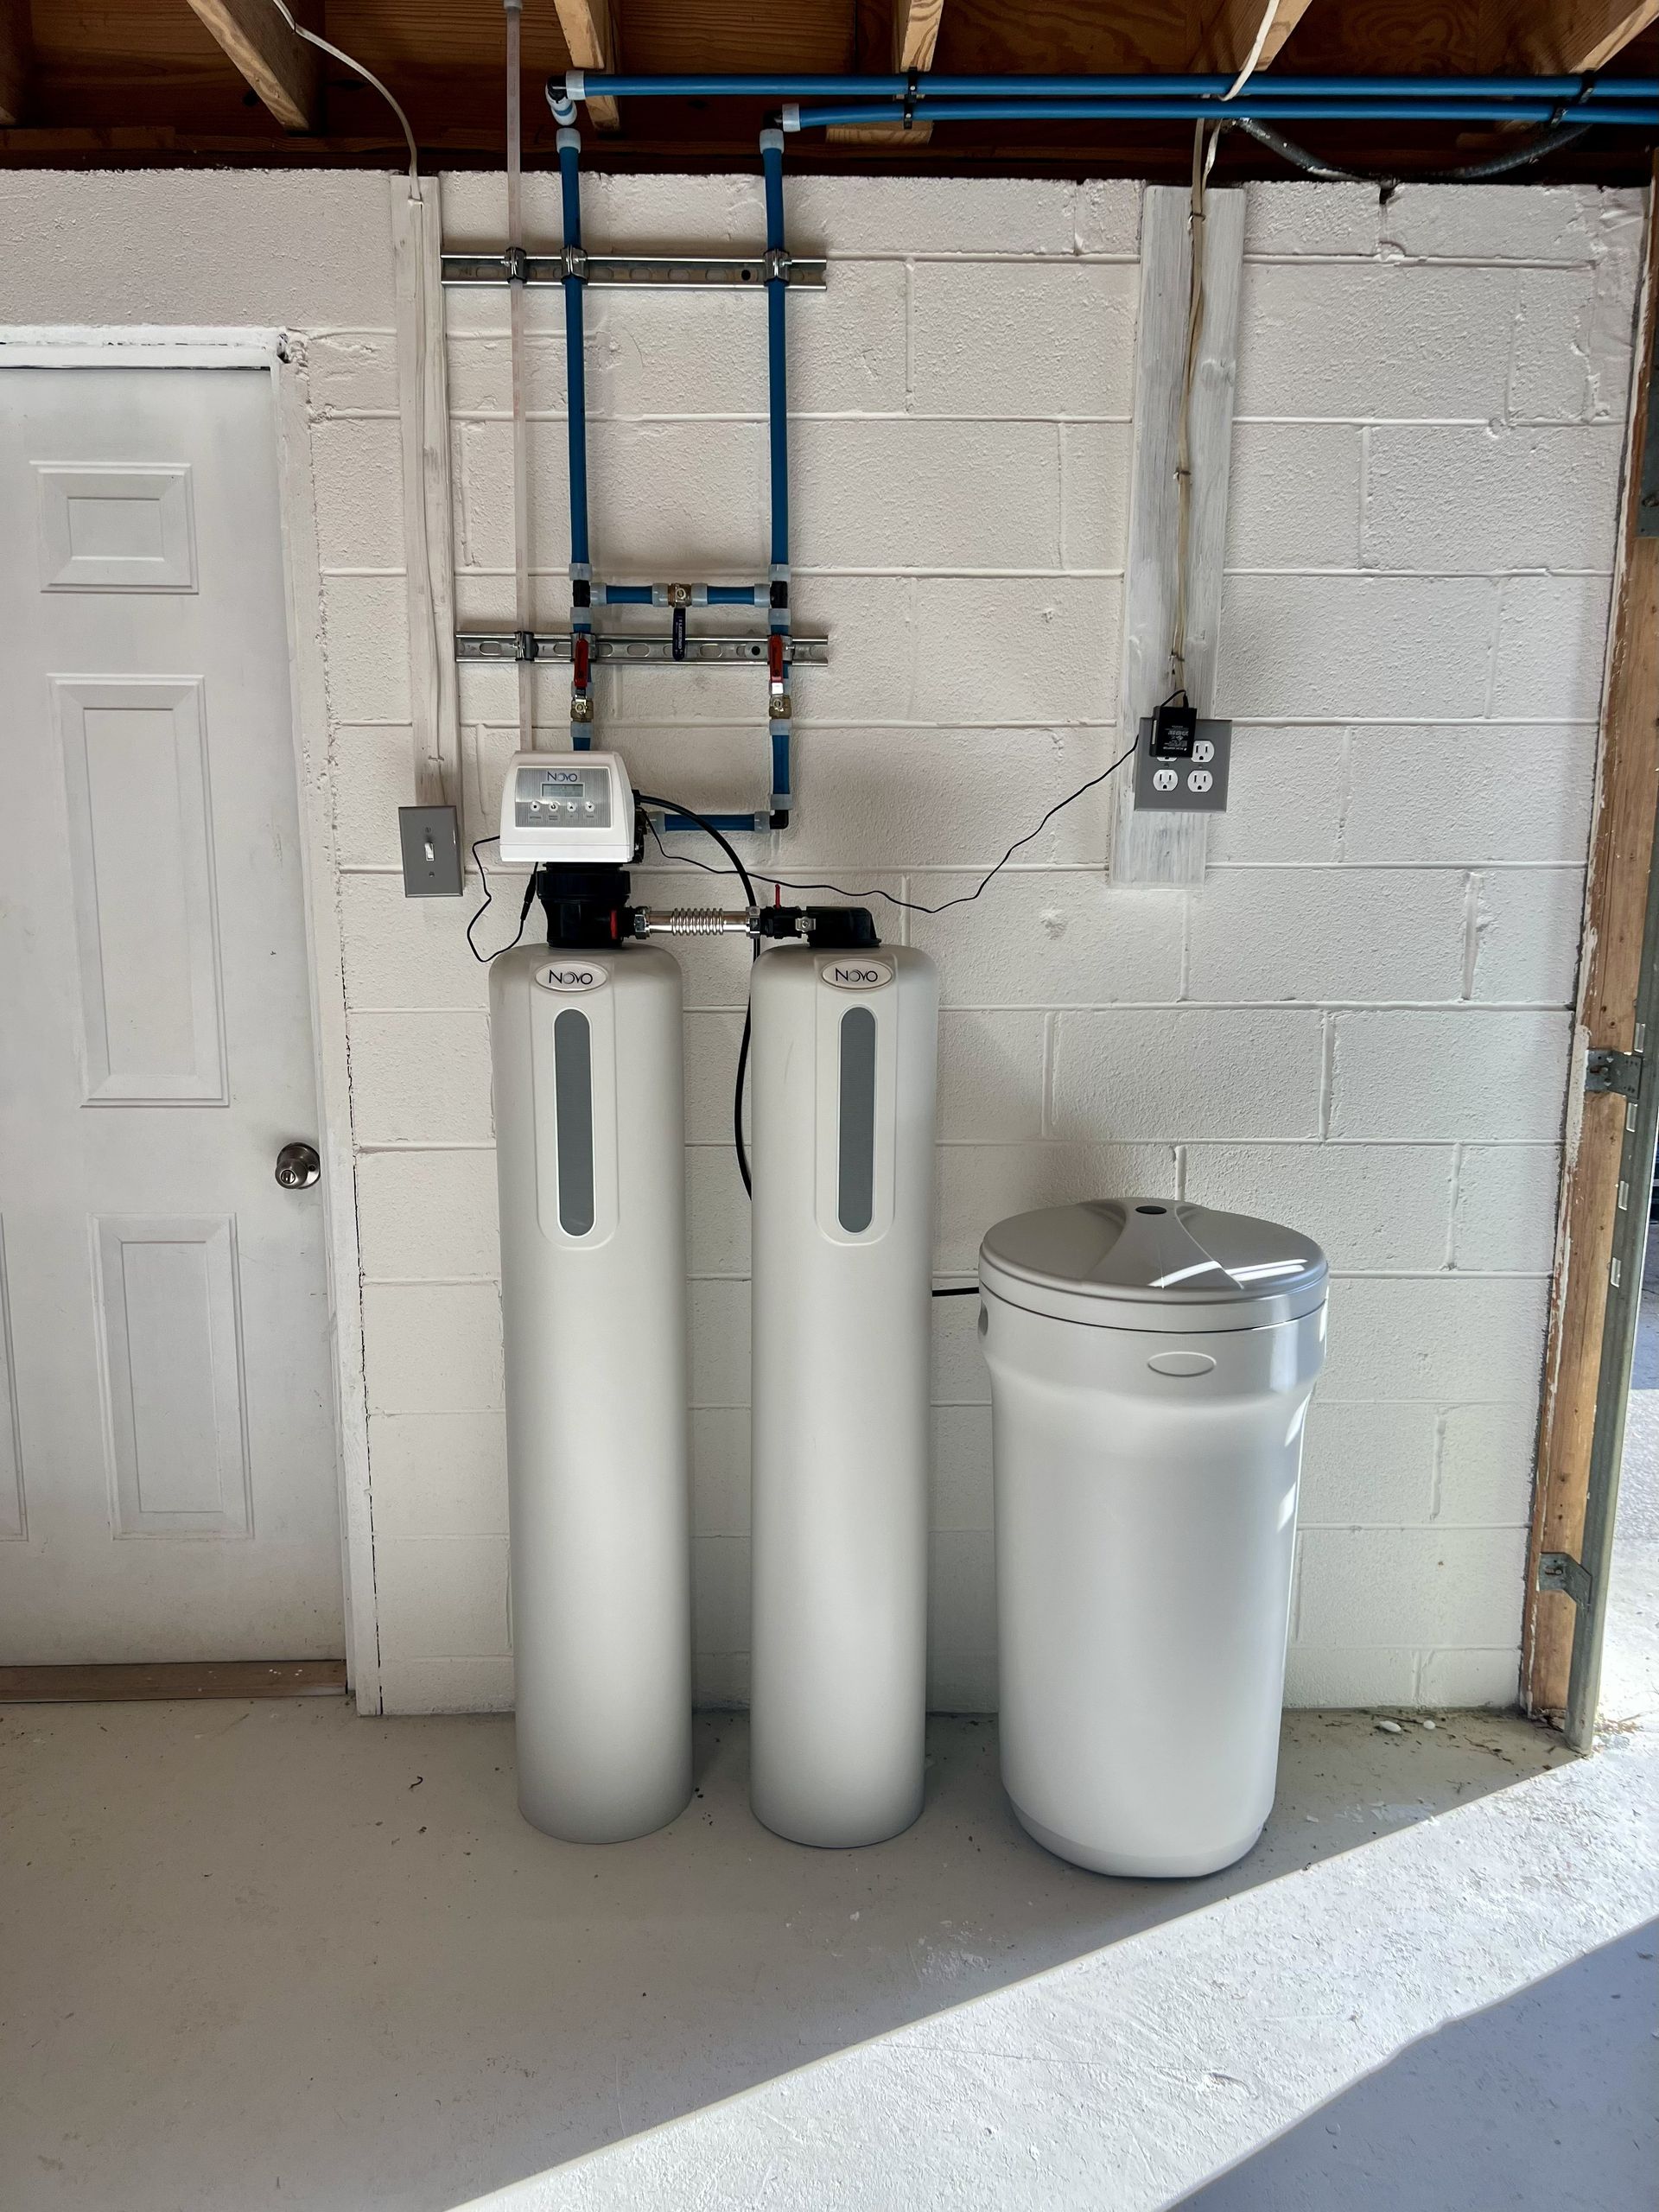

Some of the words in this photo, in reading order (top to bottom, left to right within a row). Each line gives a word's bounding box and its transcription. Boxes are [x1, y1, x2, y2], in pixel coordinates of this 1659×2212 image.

[547, 772, 577, 782] NOVO
[549, 969, 593, 985] NOVO
[835, 968, 878, 982] NOVO
